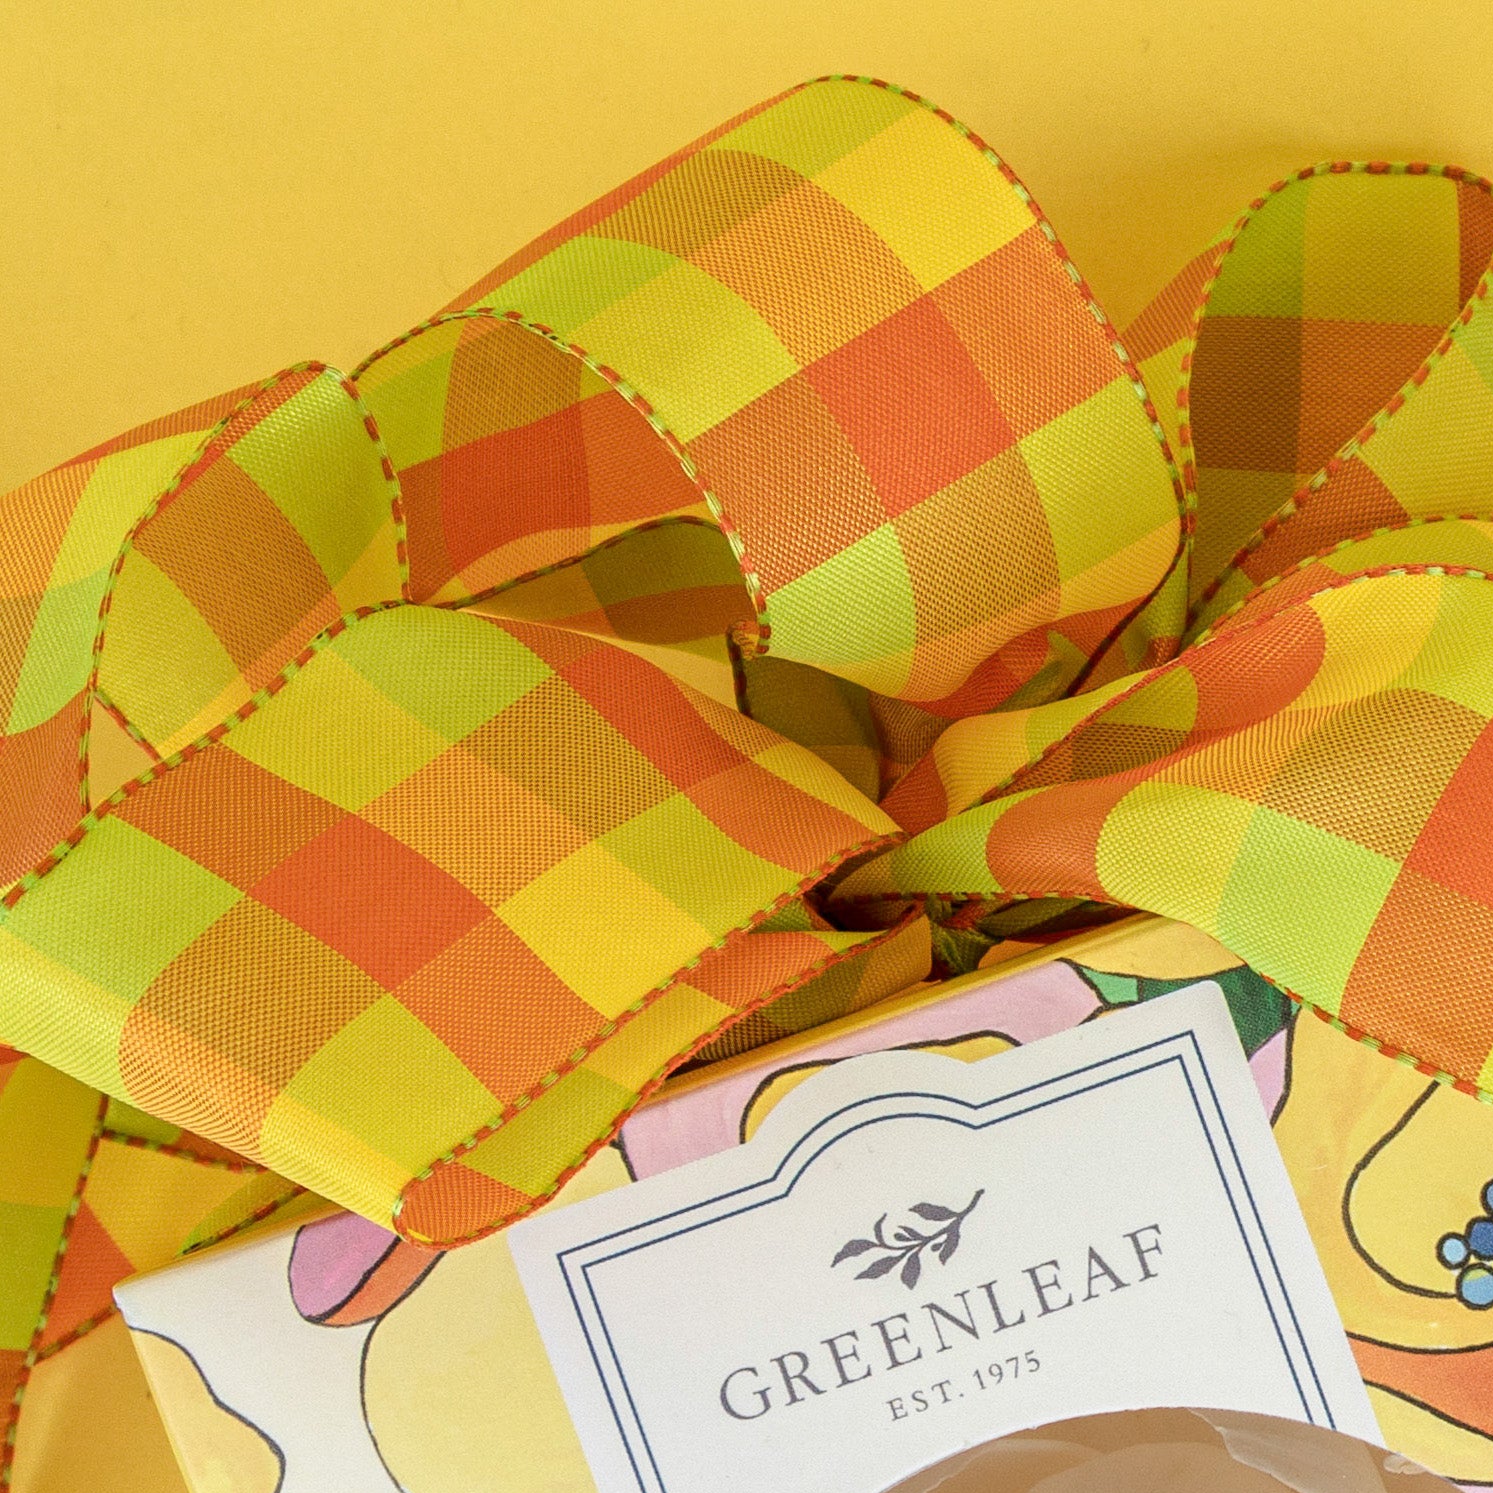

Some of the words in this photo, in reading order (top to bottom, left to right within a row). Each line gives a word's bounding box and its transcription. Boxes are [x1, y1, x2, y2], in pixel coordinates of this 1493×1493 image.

[718, 1222, 1162, 1421] GREENLEAF
[885, 1378, 964, 1422] EST.
[972, 1348, 1041, 1390] 1975
